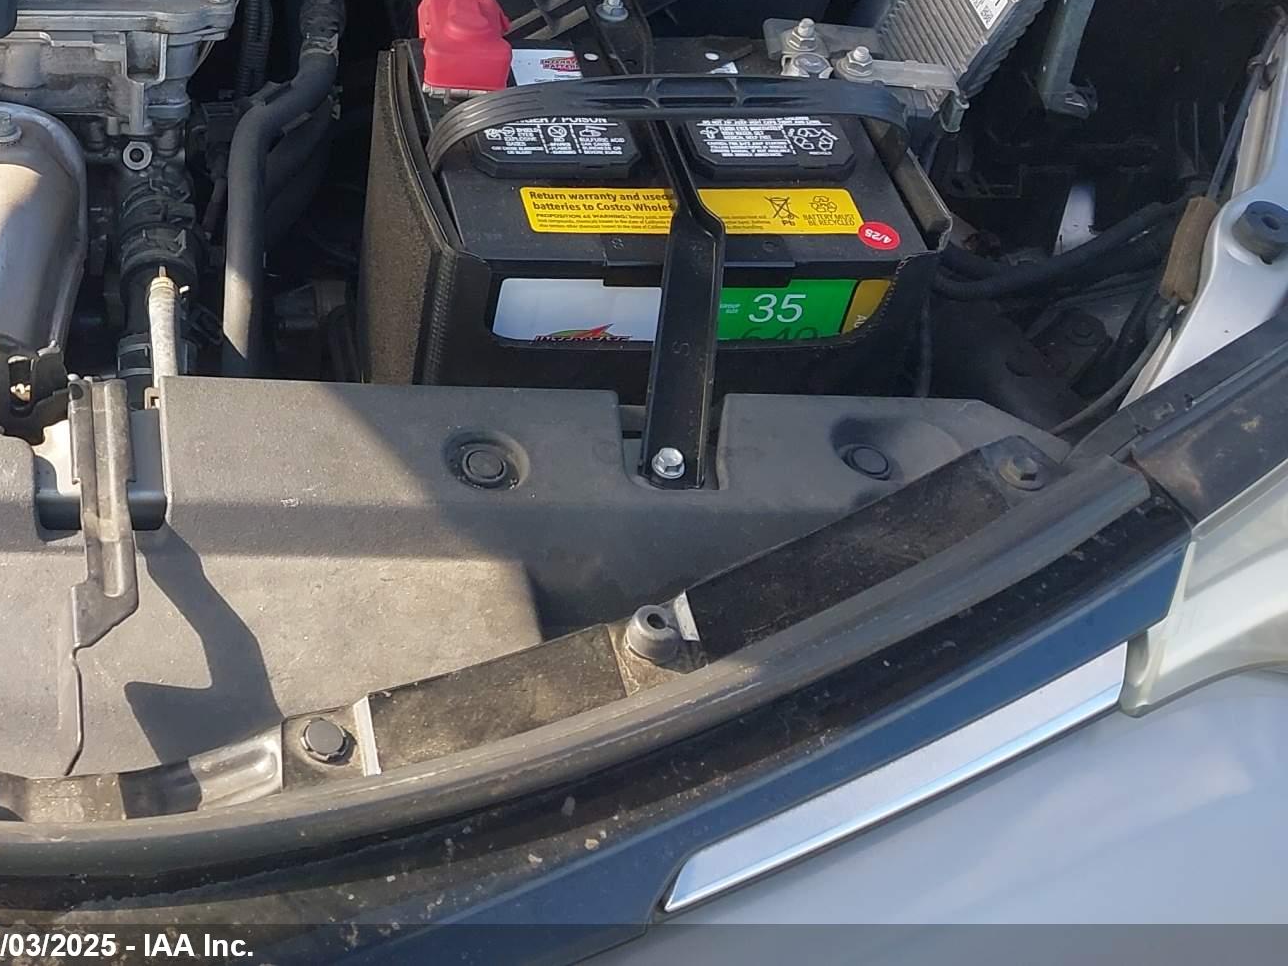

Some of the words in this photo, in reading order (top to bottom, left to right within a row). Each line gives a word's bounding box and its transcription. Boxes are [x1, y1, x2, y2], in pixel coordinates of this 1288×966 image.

[530, 191, 566, 201] Return
[569, 193, 617, 203] warranty
[620, 190, 640, 202] and
[533, 200, 580, 212] batteries
[583, 202, 595, 212] to
[597, 201, 632, 212] Costco
[865, 228, 893, 245] 4/25
[748, 293, 816, 323] 35
